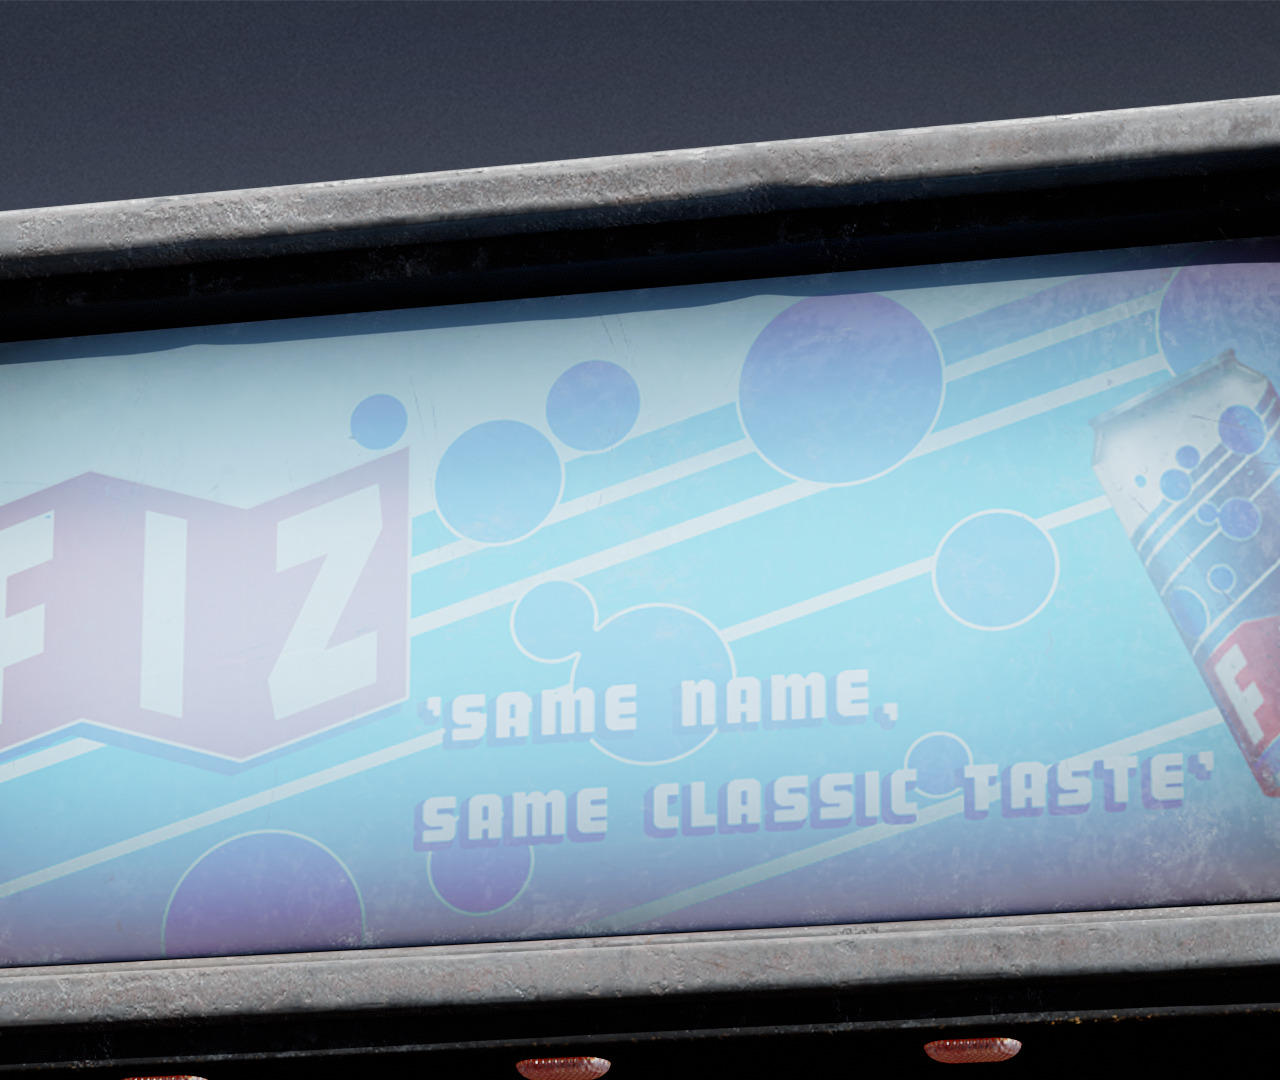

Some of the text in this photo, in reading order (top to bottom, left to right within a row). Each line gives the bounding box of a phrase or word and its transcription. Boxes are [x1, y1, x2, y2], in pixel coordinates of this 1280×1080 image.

[681, 669, 898, 727] NAME,
[422, 787, 608, 843] SAME
[653, 768, 918, 829] CLASSIC
